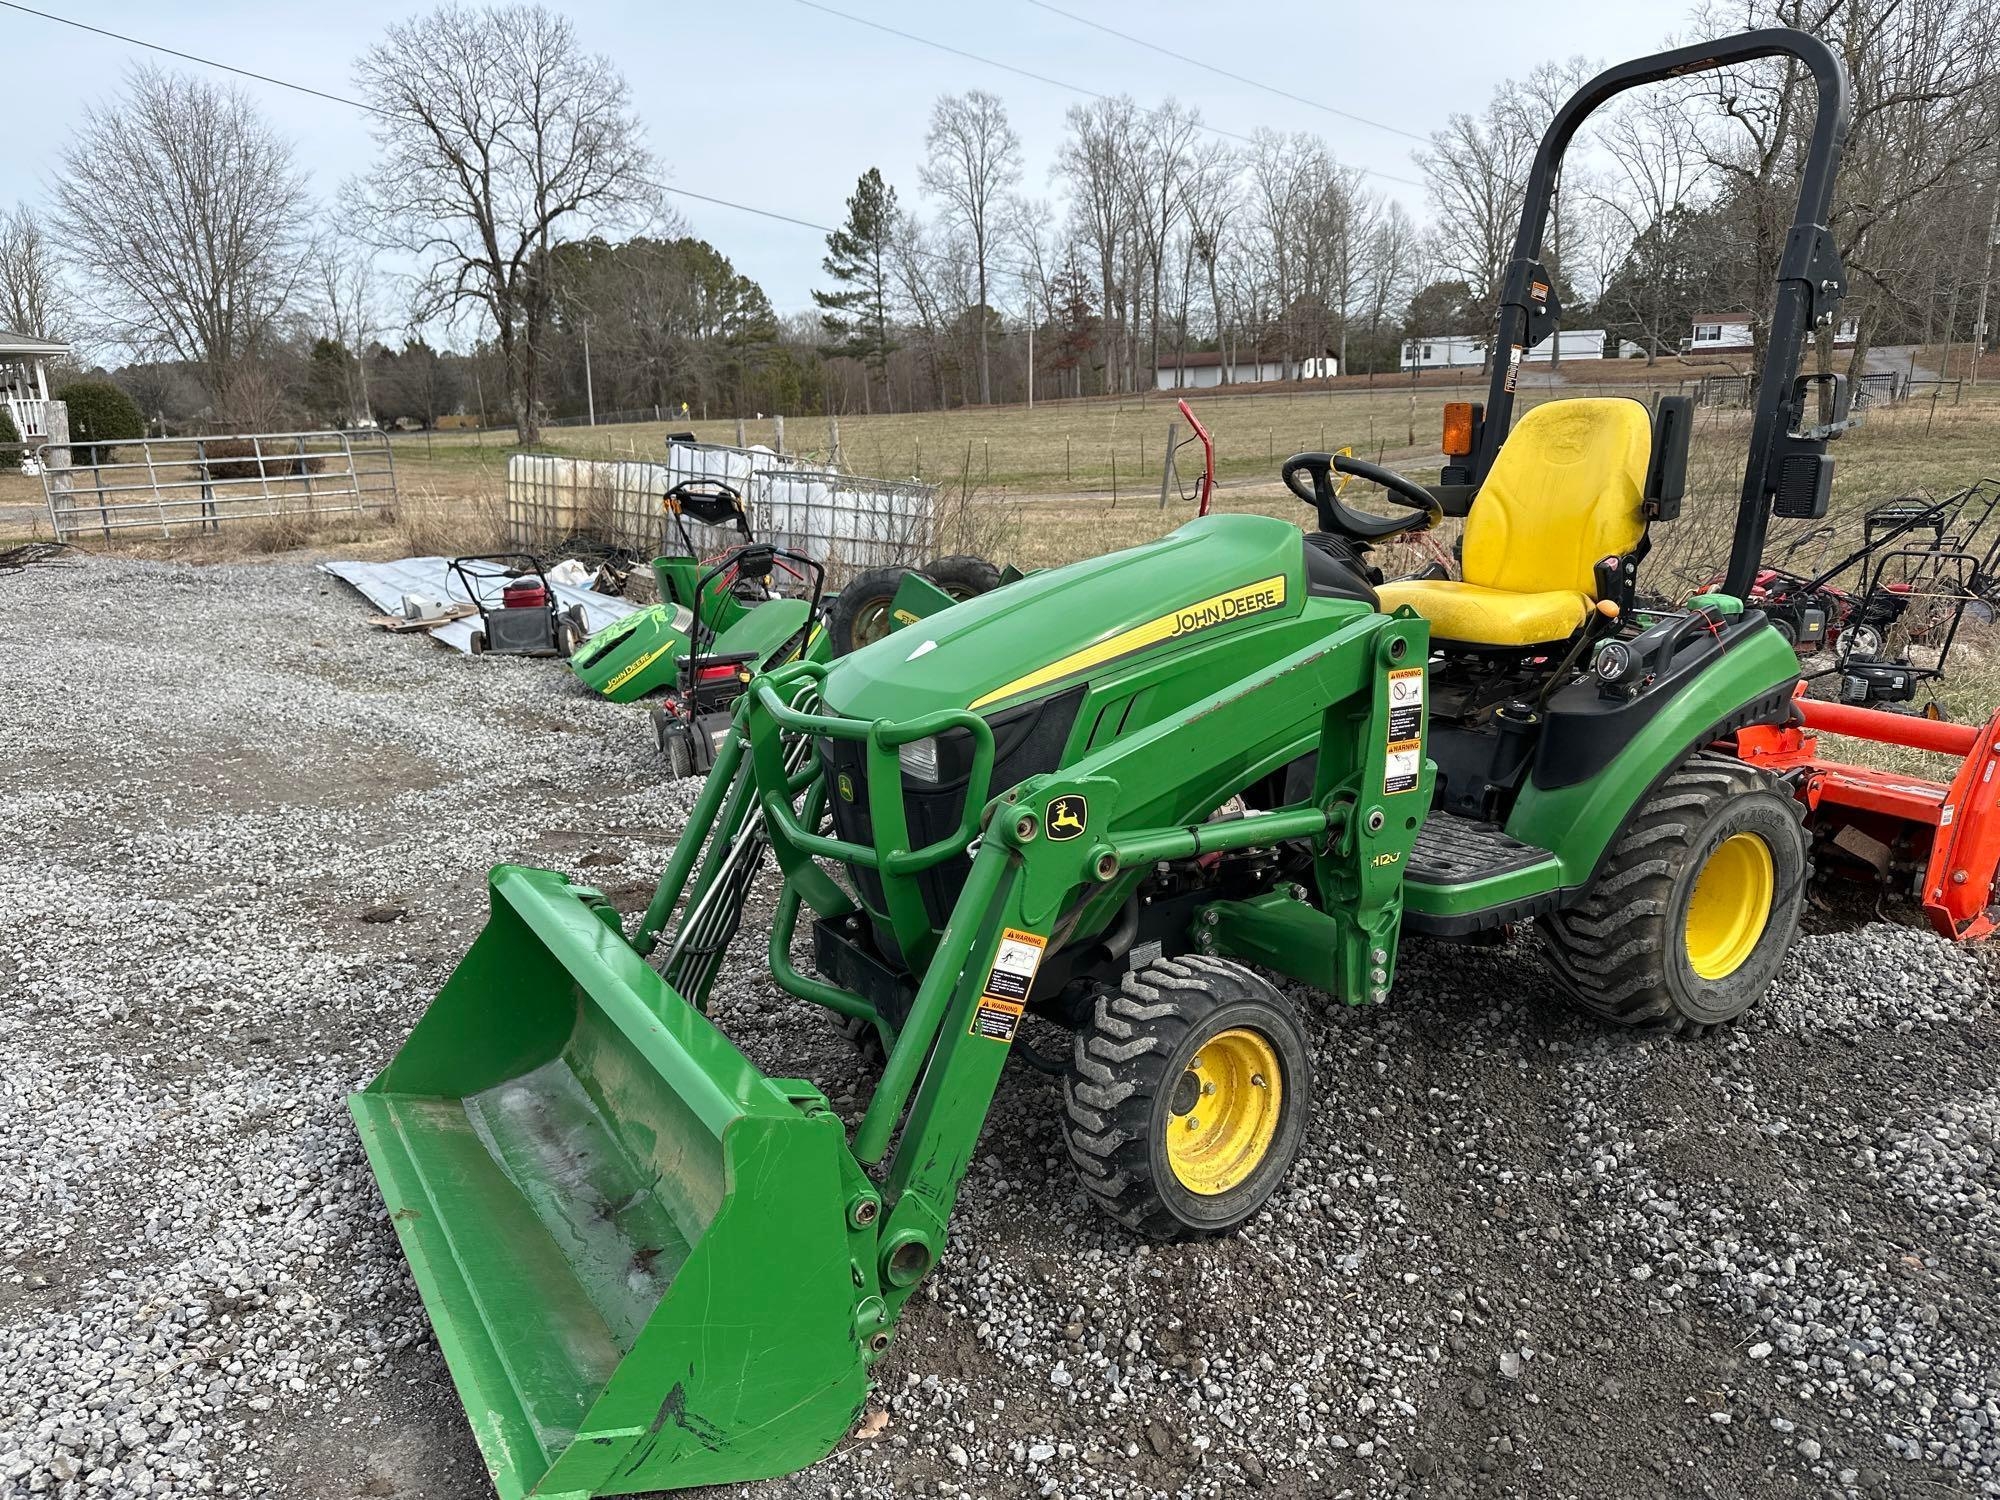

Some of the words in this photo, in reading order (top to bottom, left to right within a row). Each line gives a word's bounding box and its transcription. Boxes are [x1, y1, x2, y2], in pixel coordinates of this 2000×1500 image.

[1172, 605, 1219, 634] JOHN
[1222, 590, 1276, 617] DEERE
[607, 671, 628, 688] JOHN
[625, 651, 652, 674] DEERE
[1396, 669, 1422, 678] WARNING
[1393, 742, 1419, 752] WARNING
[1014, 933, 1042, 945] WARNING
[991, 1002, 1018, 1013] WARNING
